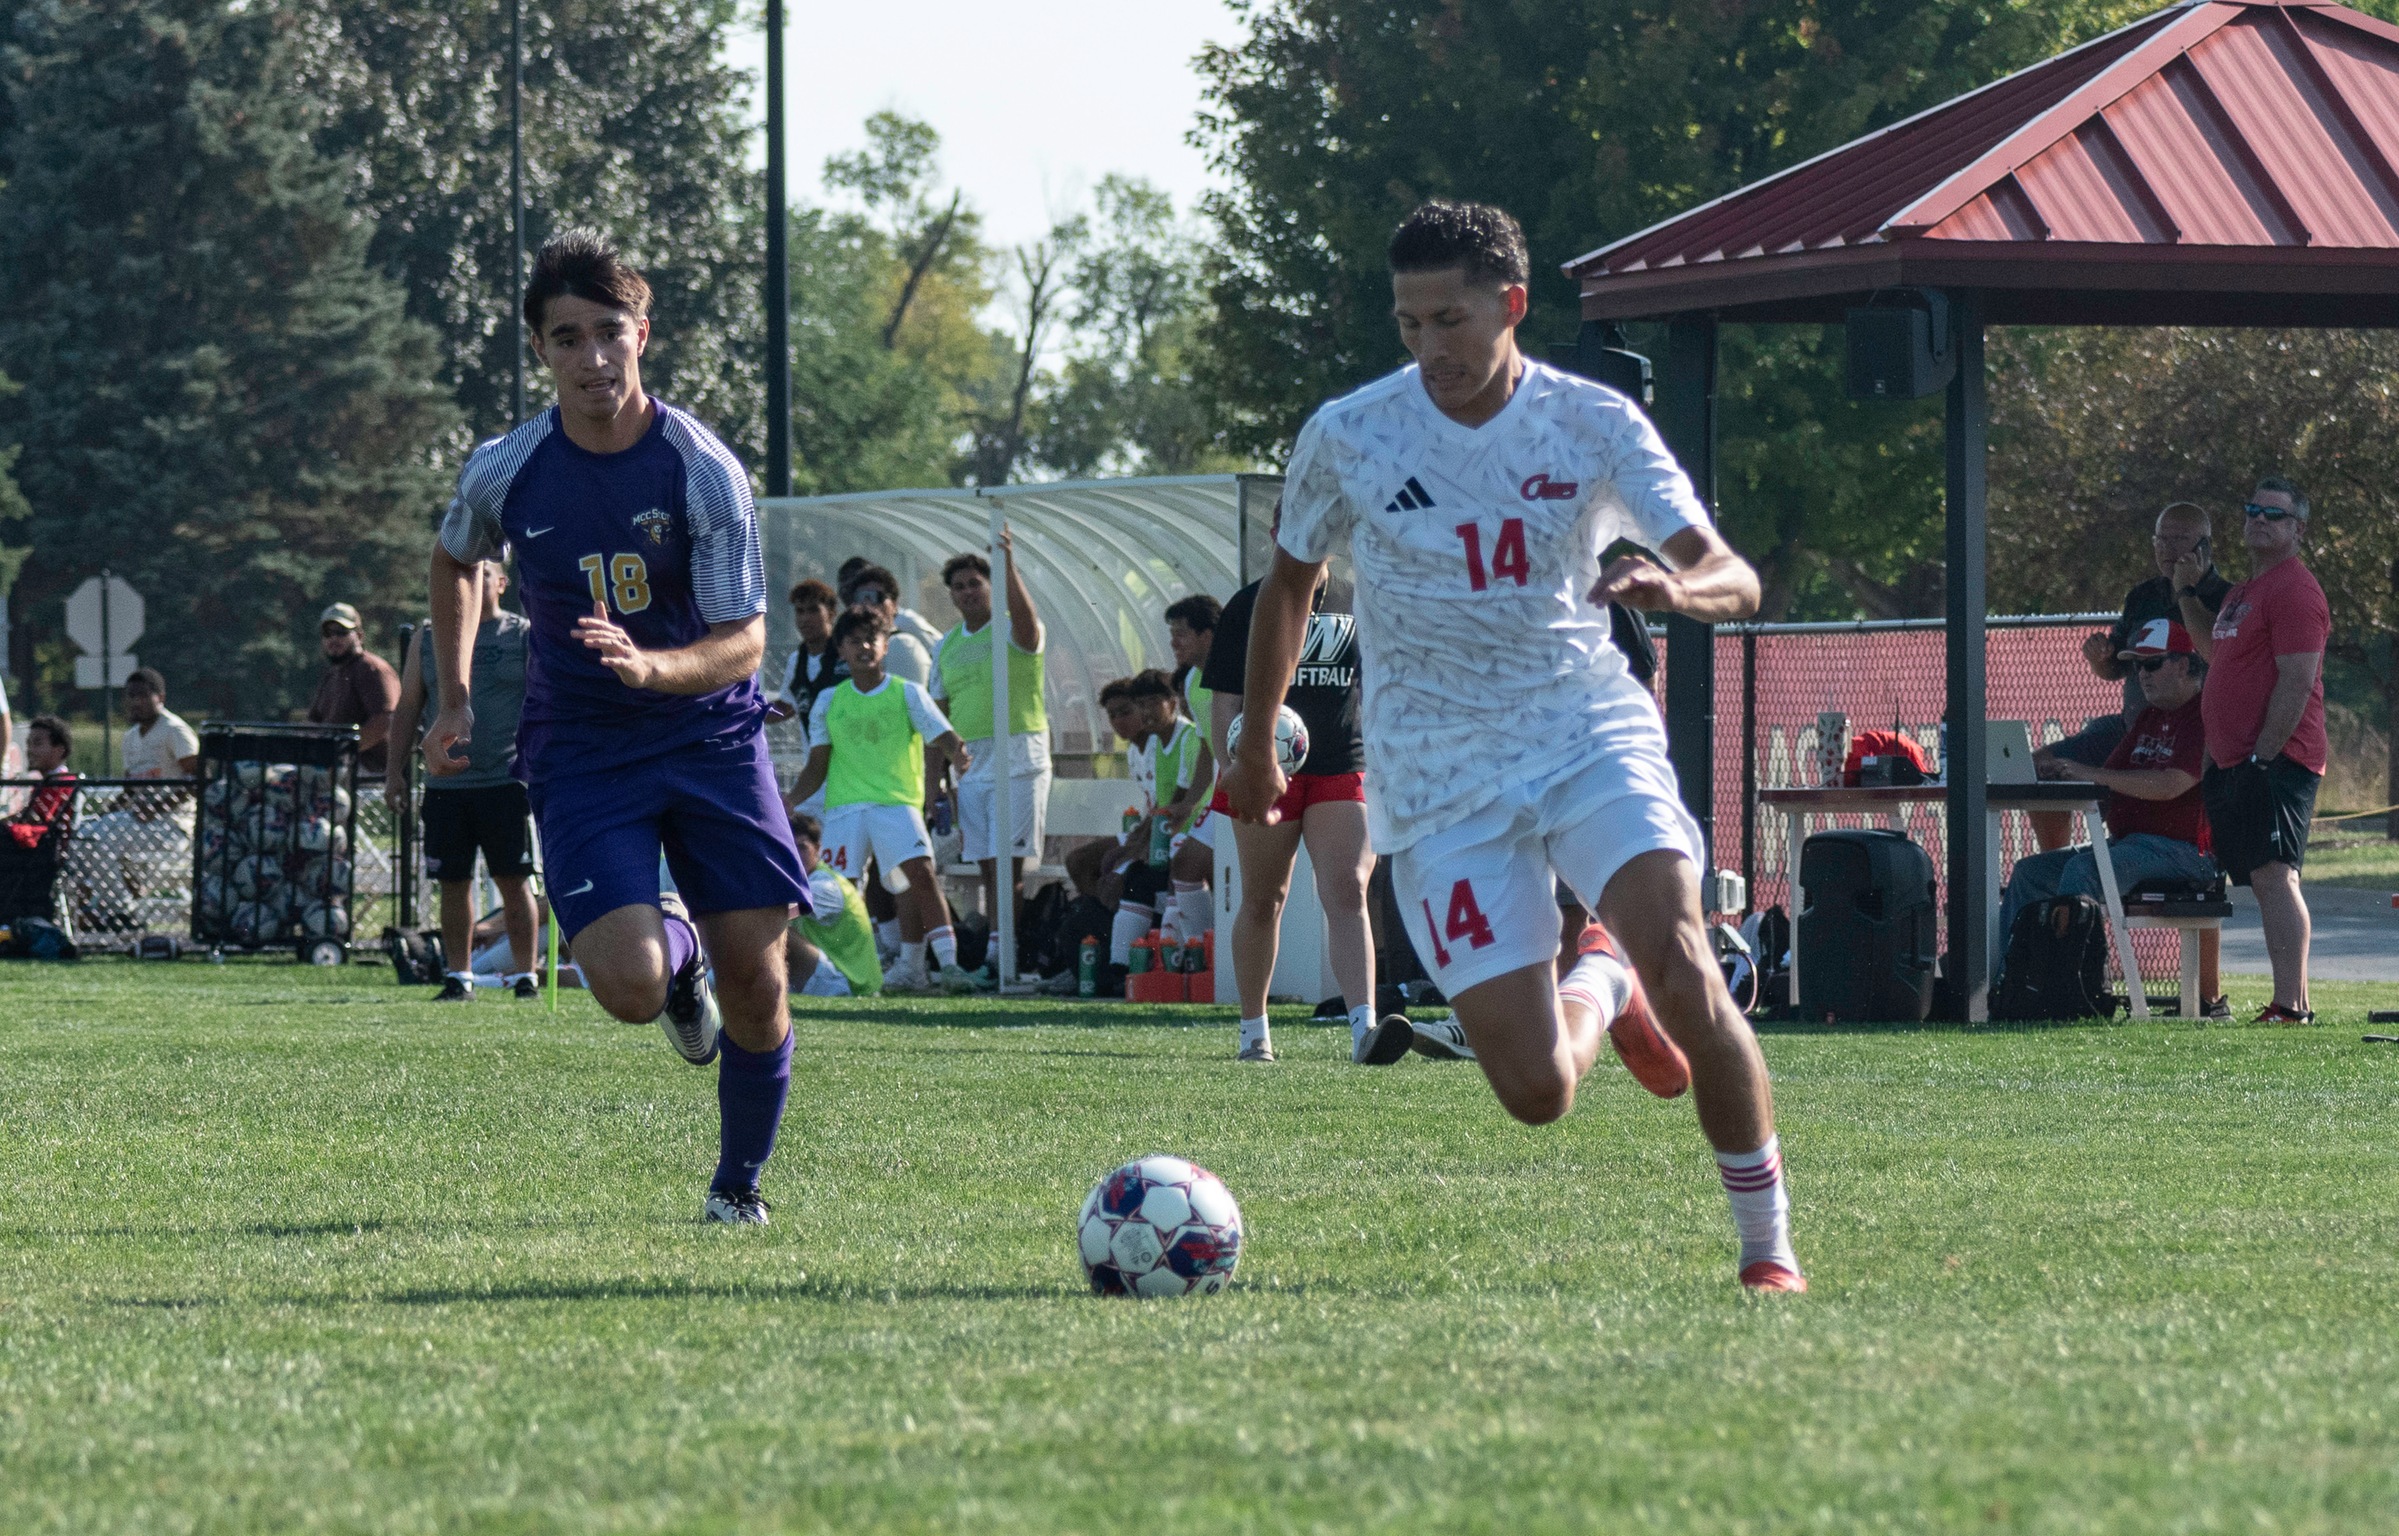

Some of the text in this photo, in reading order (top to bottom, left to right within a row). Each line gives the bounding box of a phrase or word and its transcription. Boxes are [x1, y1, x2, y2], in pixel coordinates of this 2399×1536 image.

[579, 553, 652, 615] 18
[1455, 517, 1530, 592] 14
[1422, 878, 1497, 970] 14
